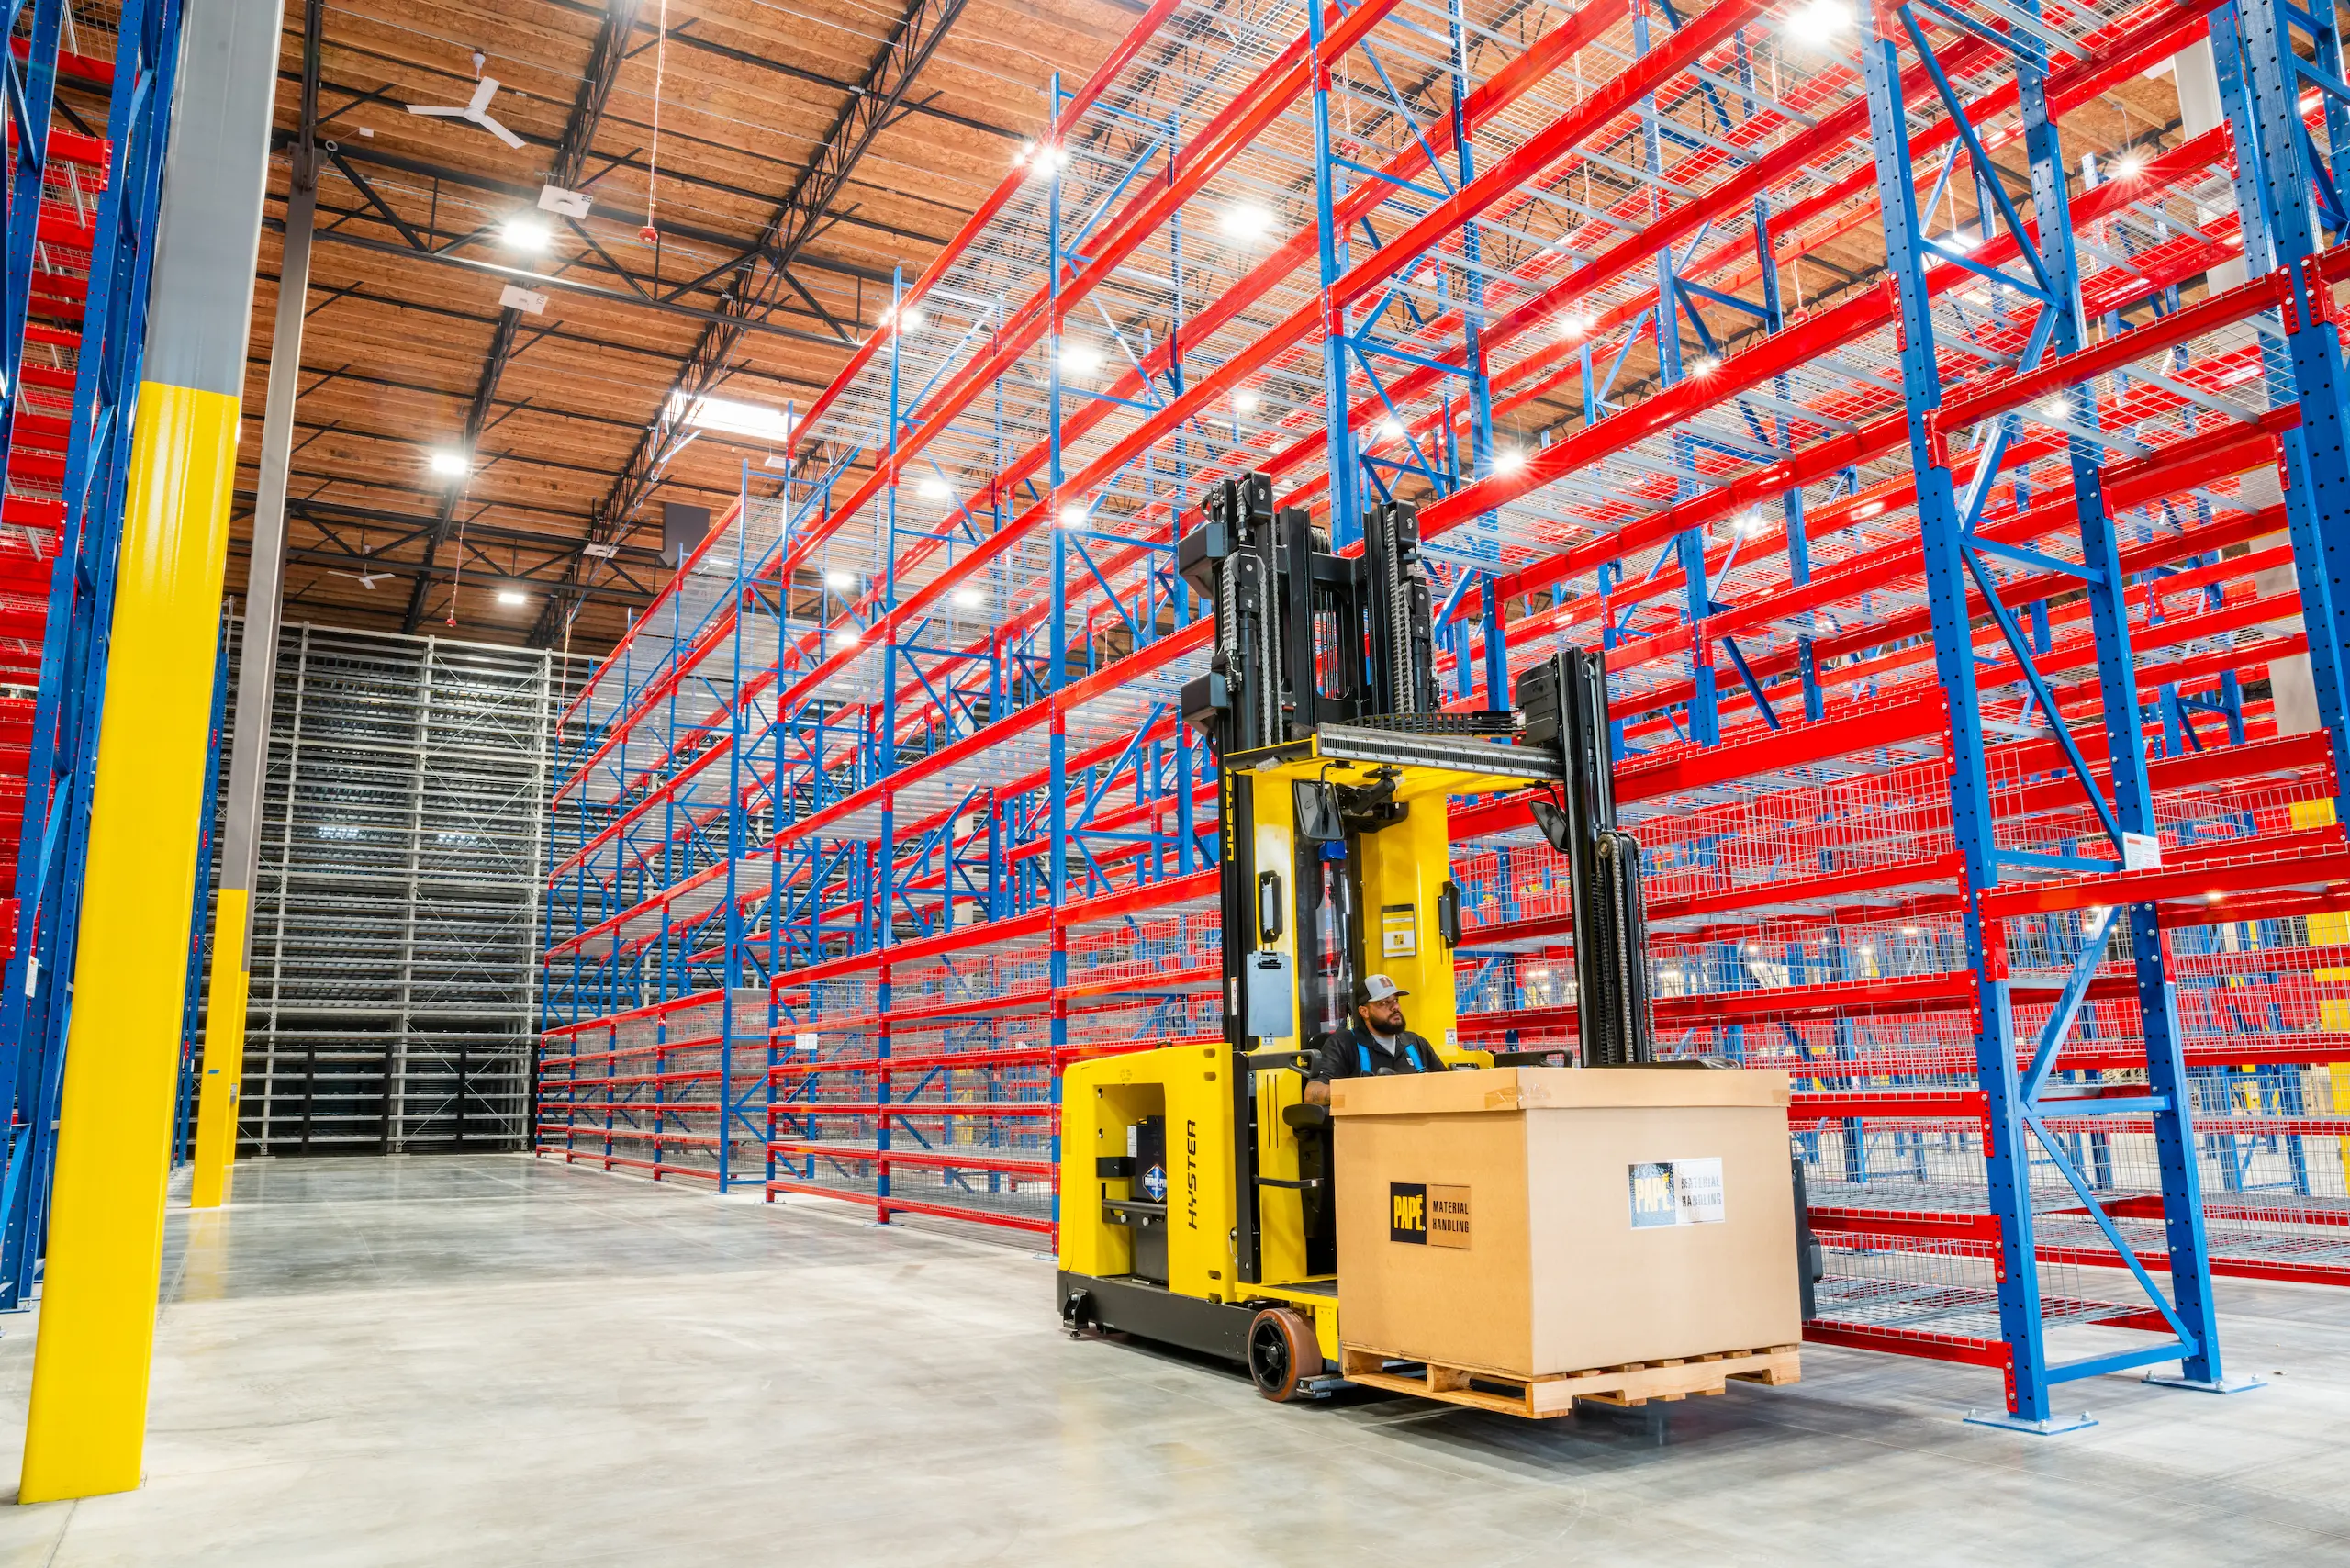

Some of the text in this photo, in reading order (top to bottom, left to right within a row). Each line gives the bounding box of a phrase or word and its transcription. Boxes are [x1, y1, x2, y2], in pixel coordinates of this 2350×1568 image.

[1225, 767, 1235, 861] HYSTE
[1187, 1119, 1197, 1230] HYSTER
[1681, 1176, 1721, 1189] MATERIAL
[1432, 1200, 1470, 1215] MATERIAL
[1682, 1193, 1722, 1207] HANDLING
[1393, 1193, 1424, 1231] PAPÉ
[1432, 1218, 1470, 1233] HANDLING
